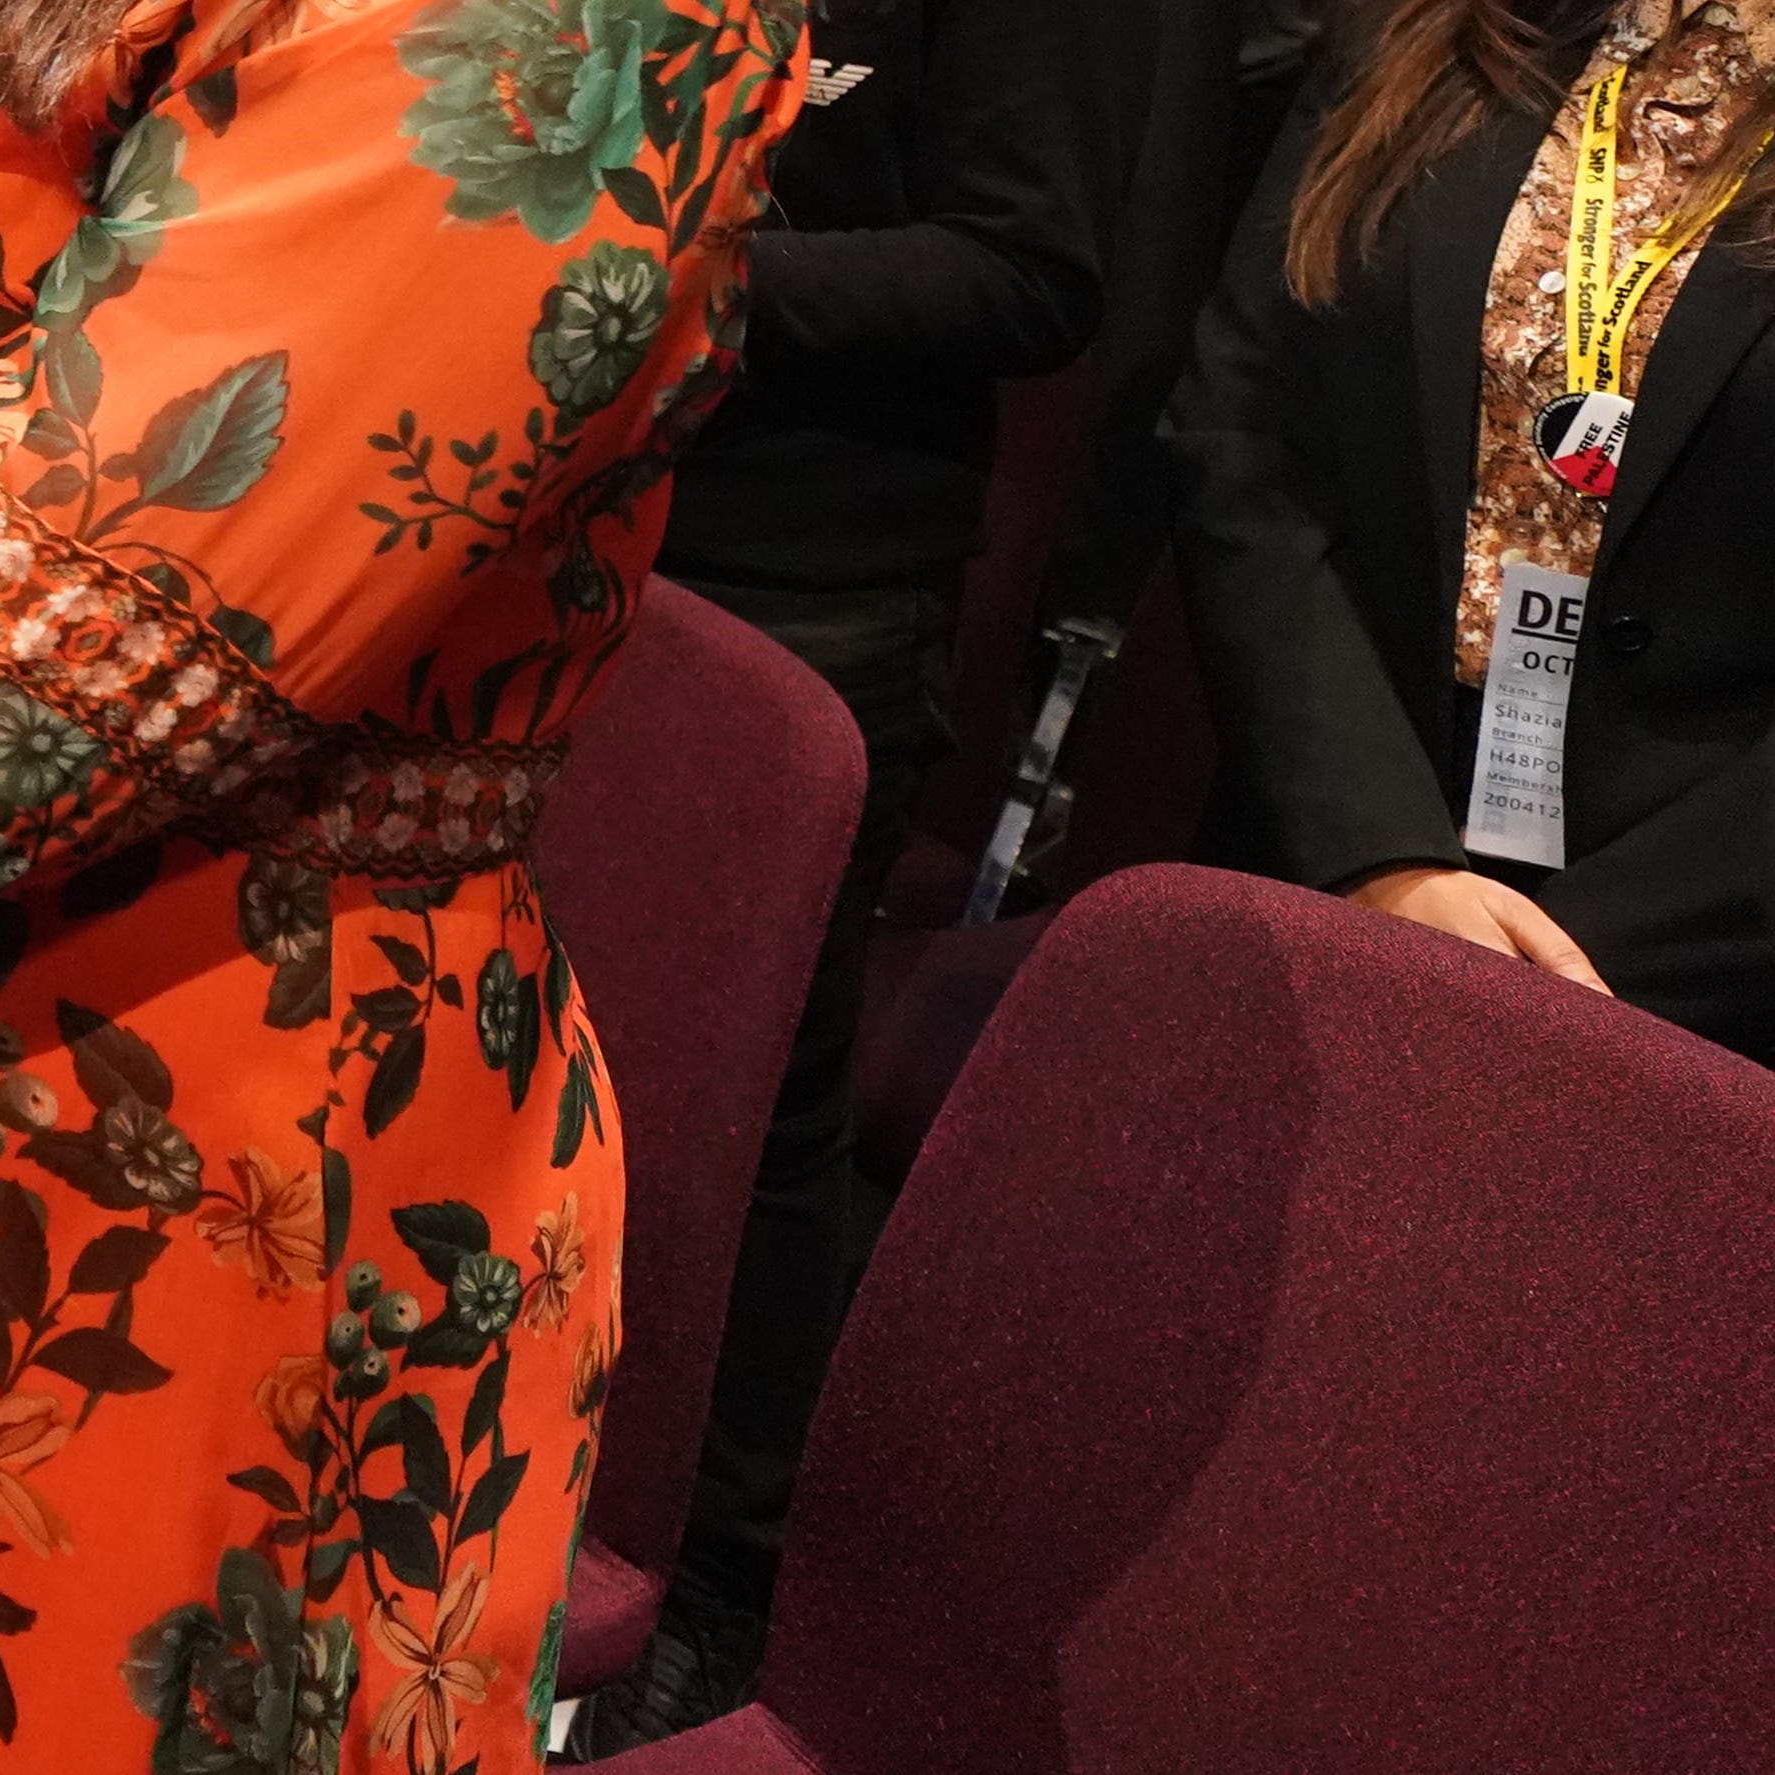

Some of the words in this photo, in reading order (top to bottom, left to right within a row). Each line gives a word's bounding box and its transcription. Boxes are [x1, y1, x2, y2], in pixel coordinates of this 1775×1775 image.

[1588, 147, 1607, 173] SNP
[1577, 198, 1604, 260] Stronger
[1581, 262, 1597, 280] for
[1603, 260, 1653, 327] Scotland
[1602, 329, 1613, 350] for
[1575, 422, 1603, 459] FREE
[1582, 411, 1633, 487] PALESTINE
[1497, 683, 1539, 698] Name
[1494, 703, 1563, 729] Shazia
[1491, 726, 1543, 744] Branch
